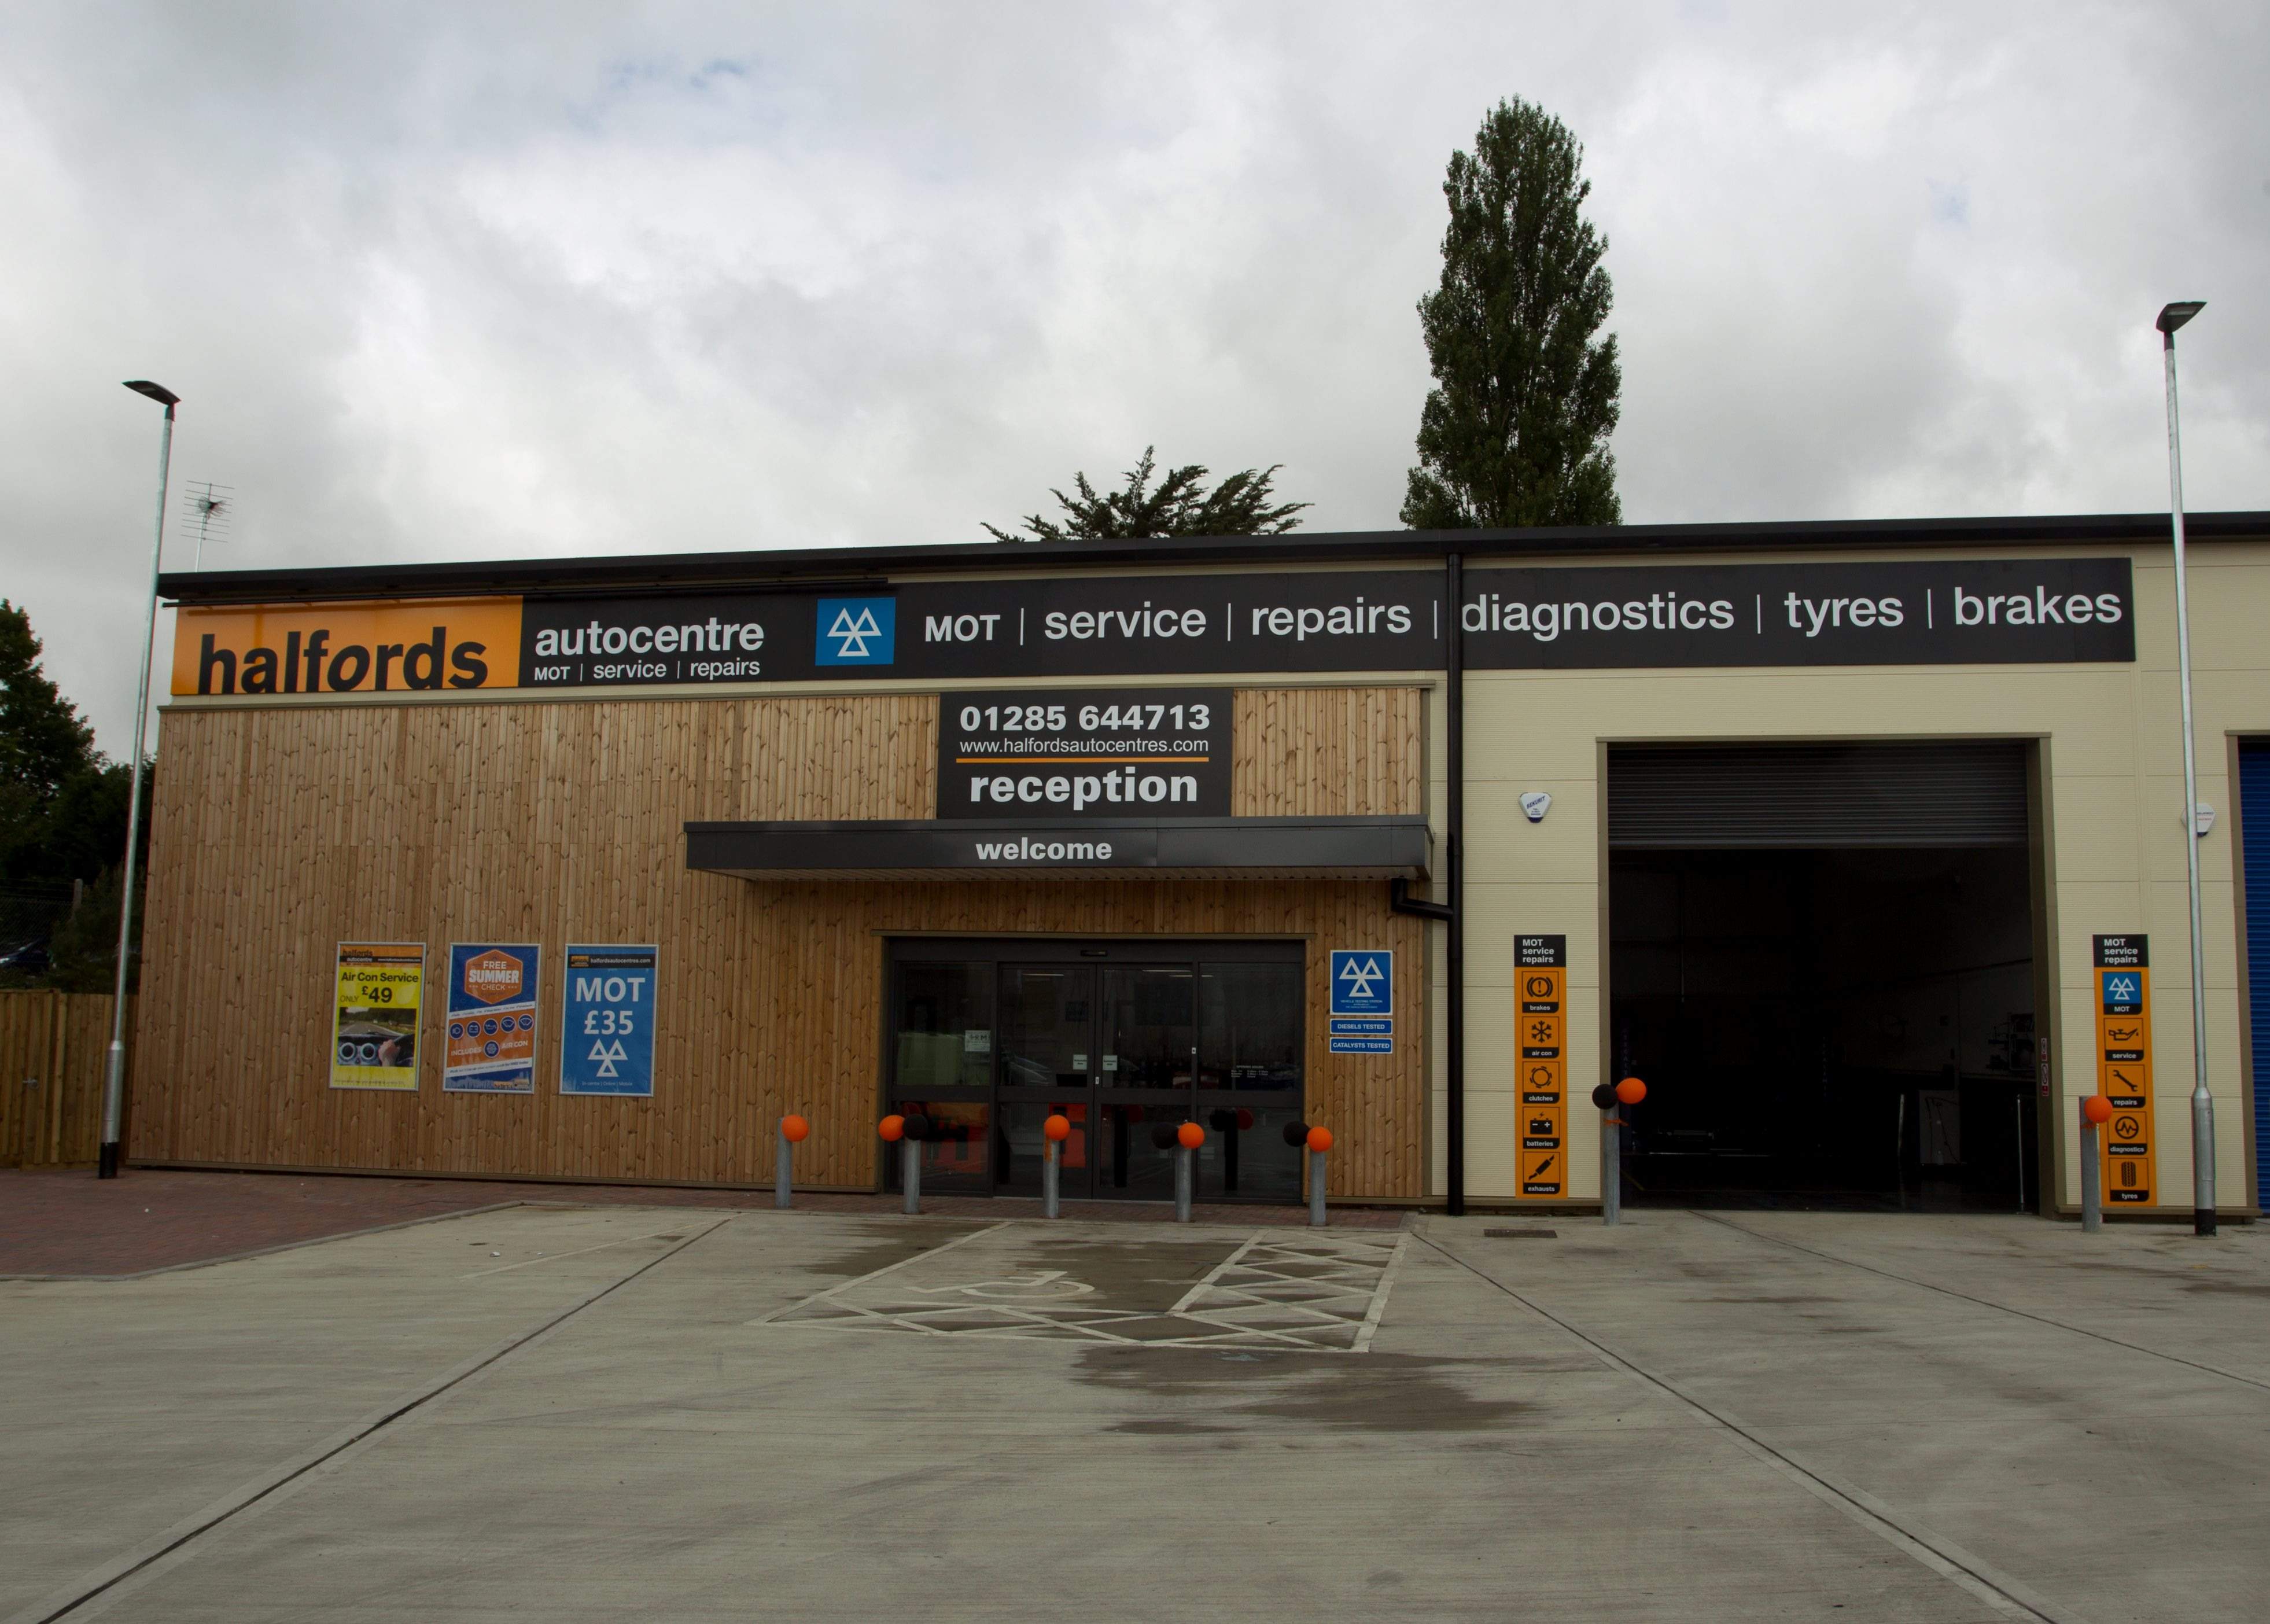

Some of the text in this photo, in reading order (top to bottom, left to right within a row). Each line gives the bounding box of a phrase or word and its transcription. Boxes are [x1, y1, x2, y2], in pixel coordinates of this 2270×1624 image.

[1784, 590, 1904, 638] tyres
[1954, 585, 2122, 625] brakes
[925, 614, 1001, 642] MOT
[1044, 601, 1207, 640] service
[1252, 596, 1412, 641] repairs
[1462, 592, 1735, 642] diagnostics
[535, 617, 764, 656] autocentre
[197, 626, 488, 694] halfords
[593, 660, 667, 679] service
[690, 657, 761, 681] repairs
[534, 666, 570, 681] MOT
[960, 704, 1210, 731] 01285 644713
[960, 737, 1209, 753] www.halfordsautocentres.com
[970, 766, 1197, 811] reception
[976, 837, 1112, 860] welcome
[2103, 938, 2126, 947] MOT
[483, 961, 507, 970] FREE
[1522, 956, 1554, 964] repairs
[2105, 956, 2138, 965] repairs
[341, 972, 419, 982] Air Con Service
[469, 970, 519, 984] SUMMER
[340, 995, 359, 1003] ONLY
[362, 985, 393, 1003] £49
[576, 977, 646, 1002] MOT
[584, 1010, 634, 1035] £35
[451, 1046, 482, 1056] INCLUDES
